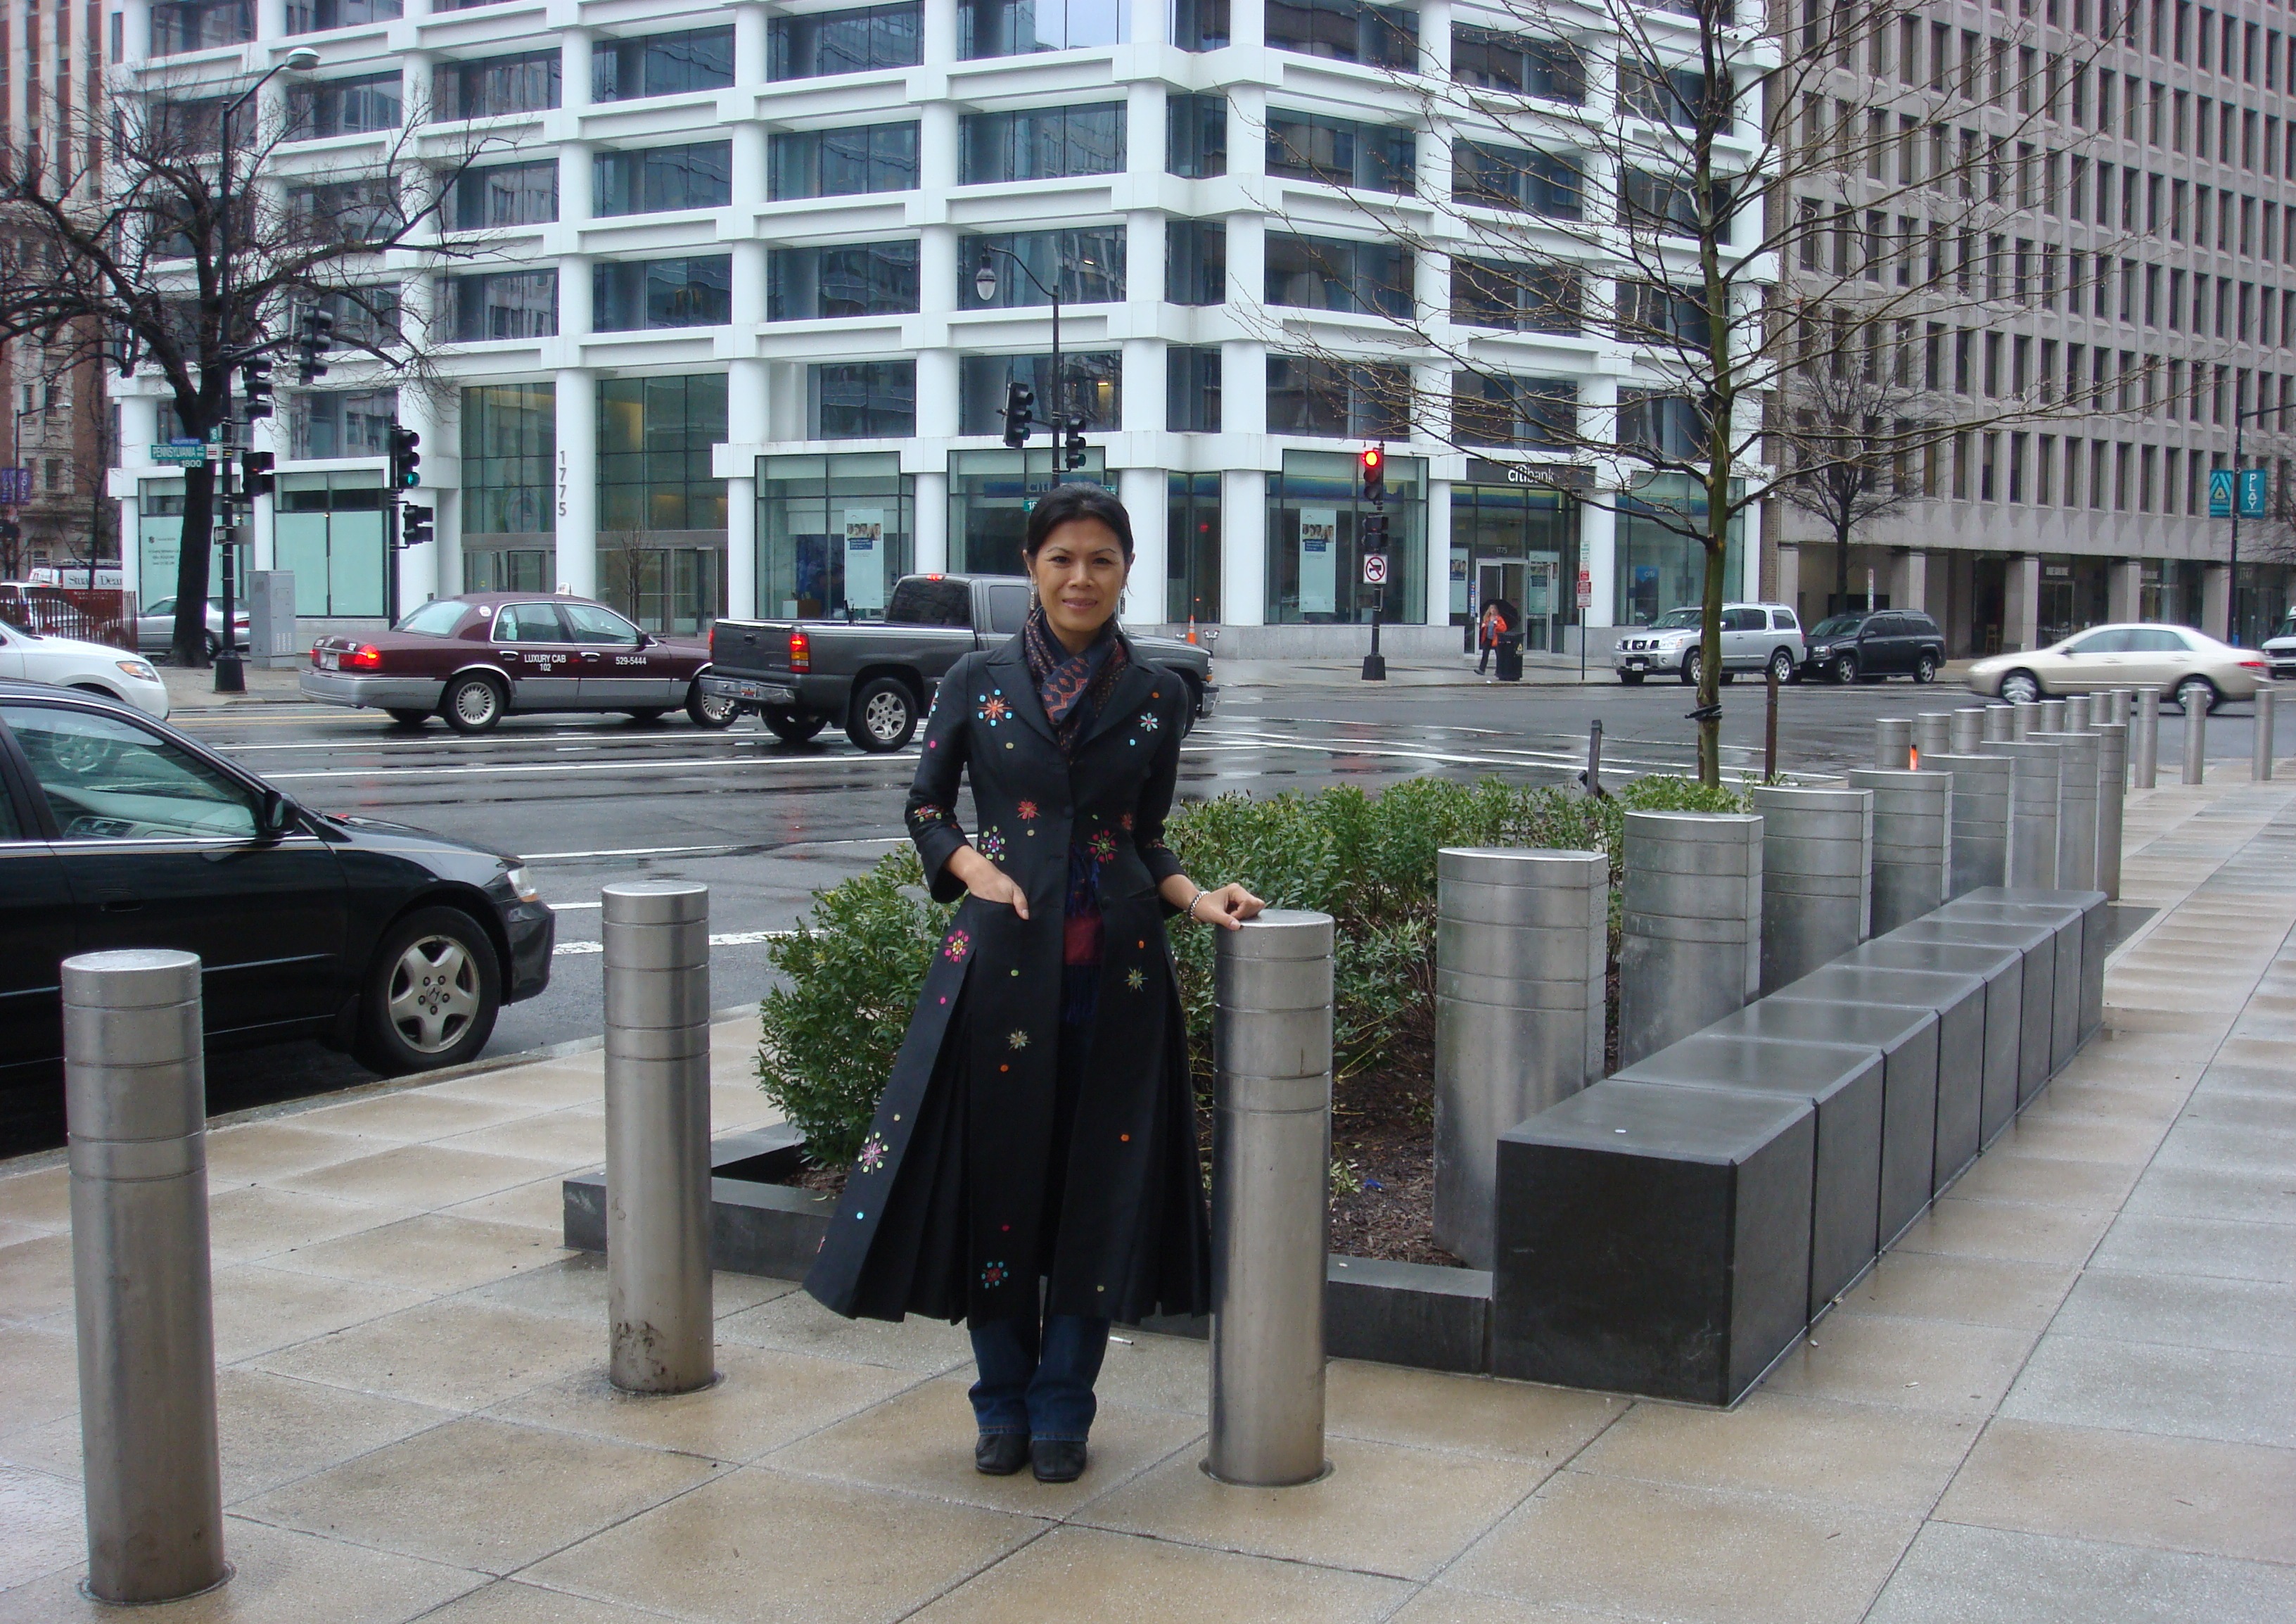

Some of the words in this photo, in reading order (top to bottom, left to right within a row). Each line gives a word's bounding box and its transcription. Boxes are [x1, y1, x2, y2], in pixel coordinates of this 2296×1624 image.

[152, 446, 196, 457] PENNSYLVANIA
[1507, 464, 1554, 483] citibank
[558, 450, 566, 516] 1775
[2247, 473, 2257, 509] PLAY
[69, 575, 96, 585] Stua
[524, 654, 550, 664] LUXURY
[551, 654, 566, 664] CAB
[615, 656, 647, 665] 529-5444
[540, 663, 551, 671] 102
